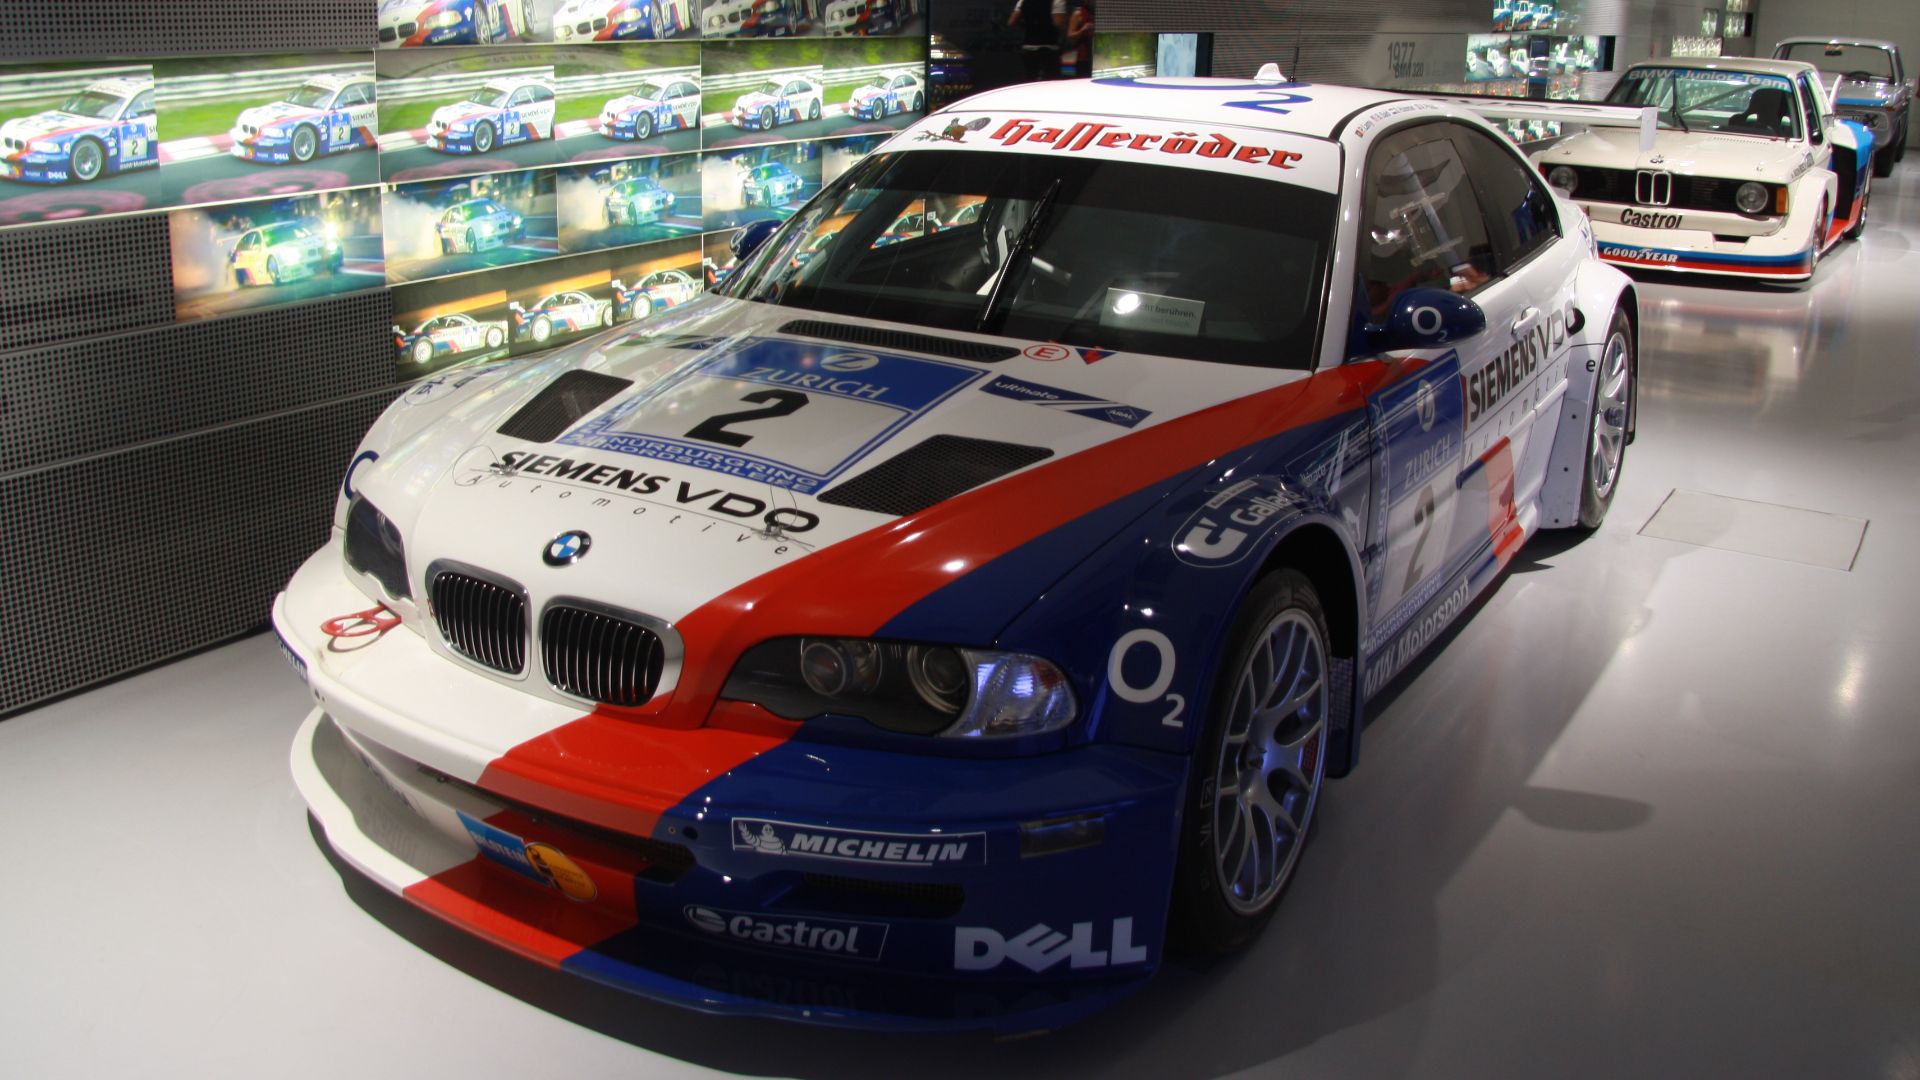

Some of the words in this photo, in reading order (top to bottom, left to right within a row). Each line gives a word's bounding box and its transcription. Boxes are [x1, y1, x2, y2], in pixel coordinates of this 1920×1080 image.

[1387, 42, 1416, 70] 1977
[1628, 69, 1675, 80] BMW
[131, 140, 139, 155] 2
[1620, 208, 1683, 229] Castrol
[1470, 328, 1537, 423] SIEMENS
[1536, 298, 1586, 361] VDO
[738, 366, 890, 400] ZURICH
[994, 381, 1060, 400] ultimate
[683, 388, 810, 448] 2
[1404, 433, 1451, 491] ZURICH
[490, 451, 671, 494] SIEMENS
[676, 481, 820, 533] VDO
[1402, 484, 1435, 598] 2
[789, 832, 968, 862] MICHELIN
[728, 914, 860, 954] Castrol
[954, 916, 1148, 974] DELL
